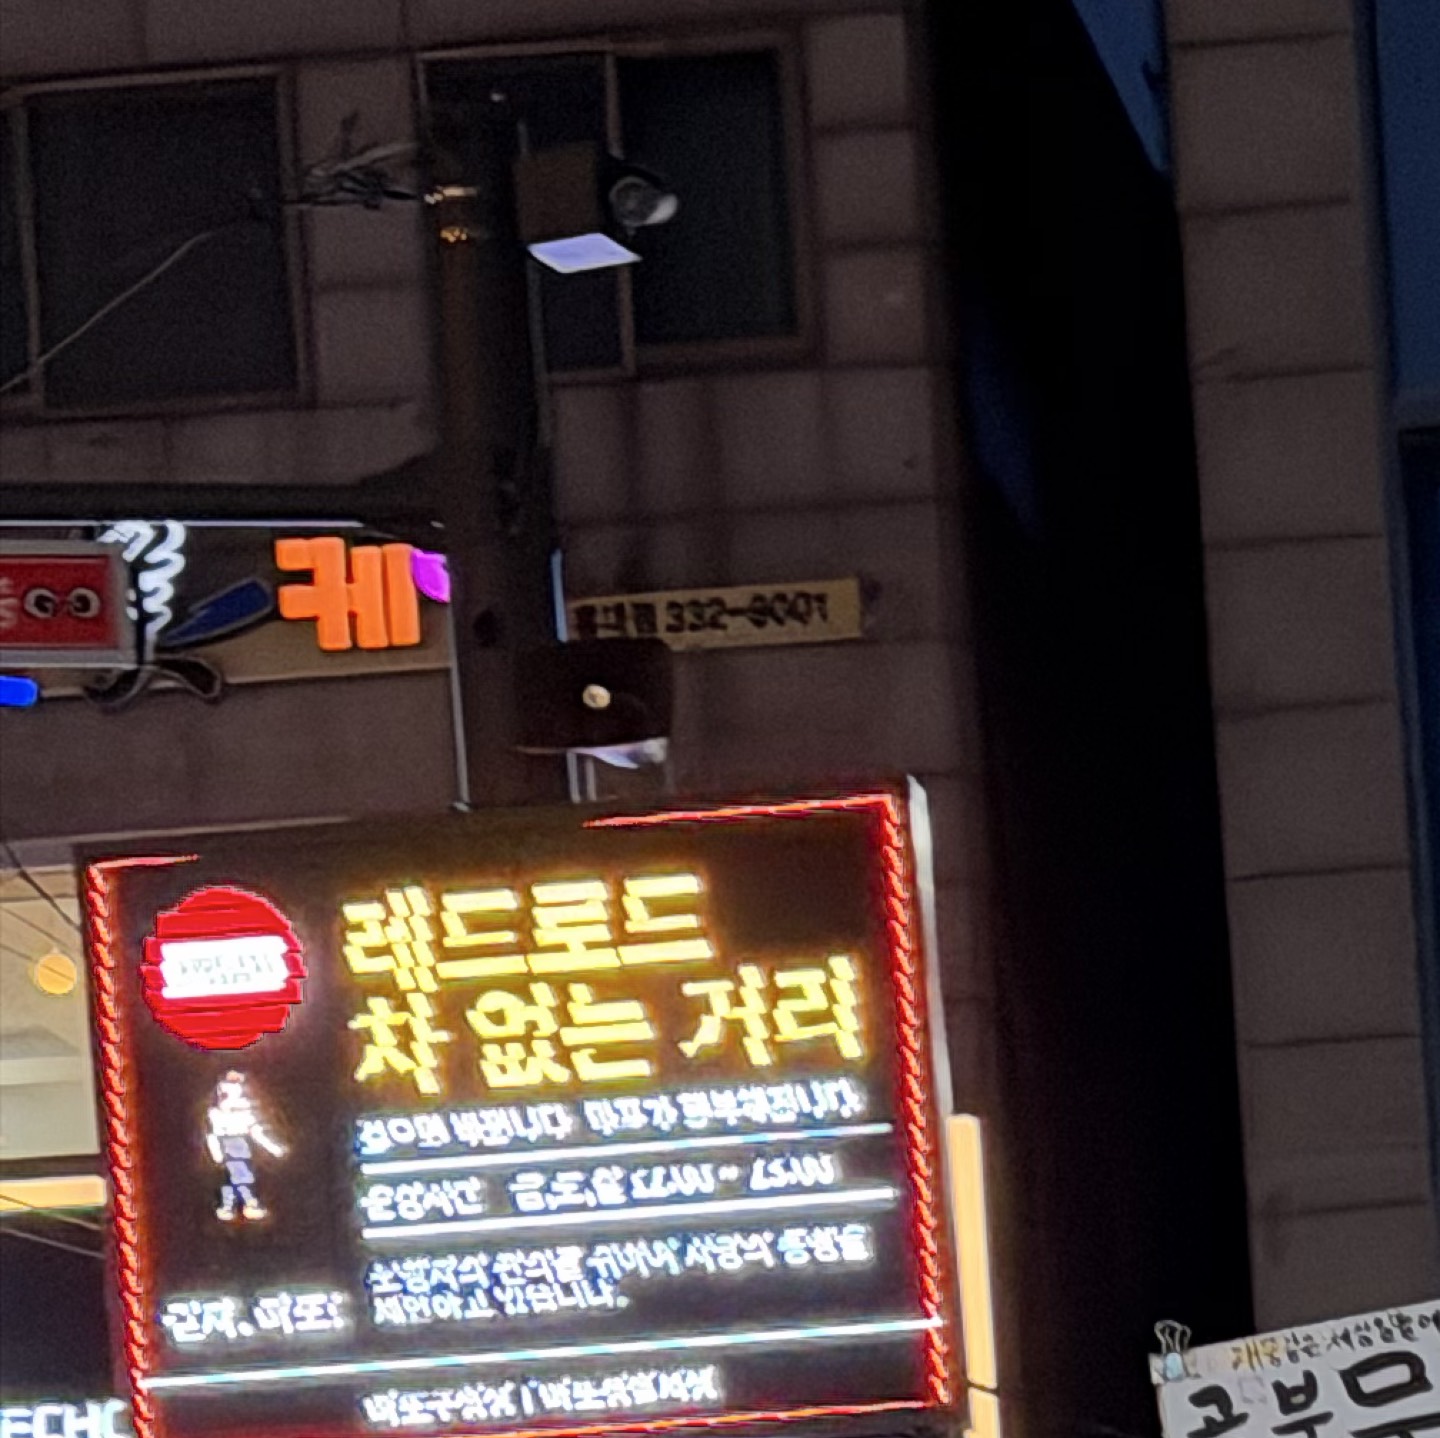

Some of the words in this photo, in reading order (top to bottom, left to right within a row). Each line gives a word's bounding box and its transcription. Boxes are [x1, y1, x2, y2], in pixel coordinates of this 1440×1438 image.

[341, 874, 715, 993] 레드로드
[348, 990, 452, 1094] 차
[465, 981, 656, 1090] 없는
[678, 953, 864, 1069] 거리
[361, 1176, 484, 1222] 운영시간
